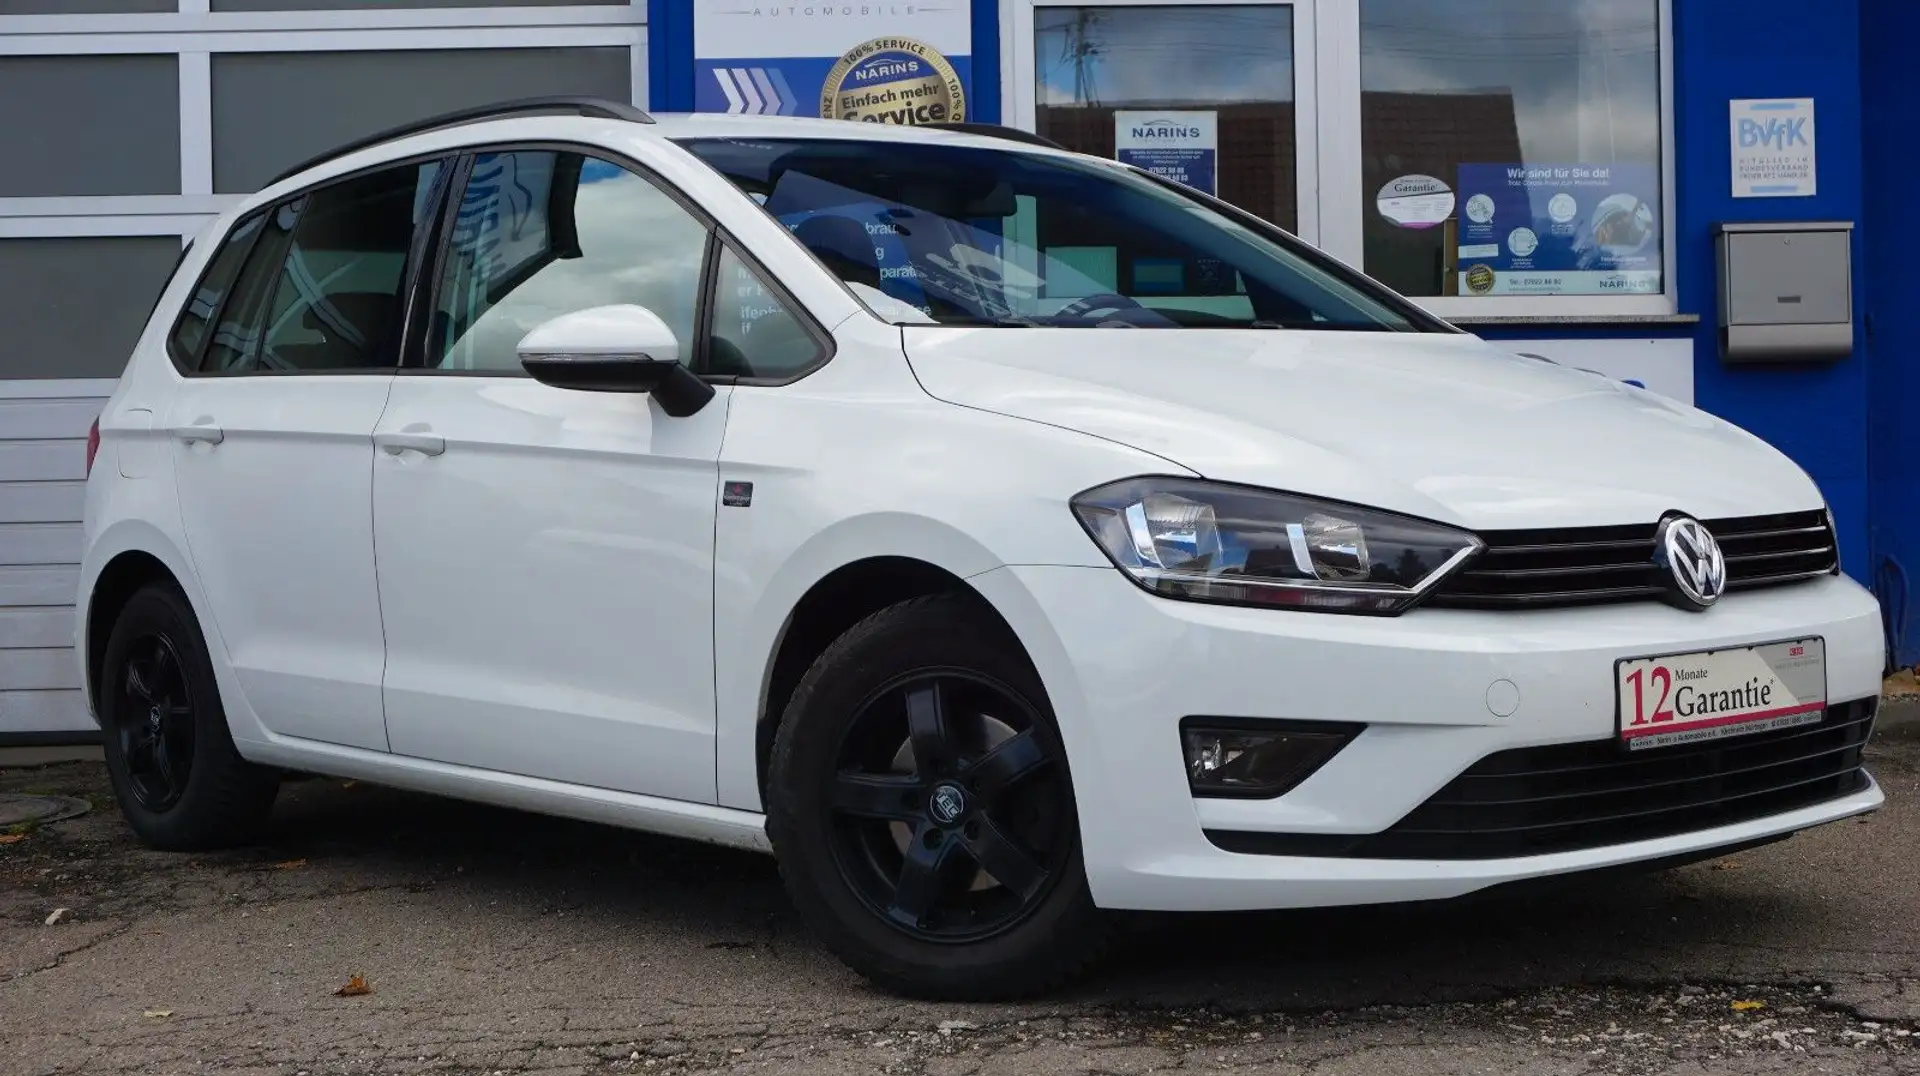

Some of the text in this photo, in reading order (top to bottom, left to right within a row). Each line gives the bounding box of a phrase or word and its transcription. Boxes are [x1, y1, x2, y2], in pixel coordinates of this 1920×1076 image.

[753, 7, 914, 16] AUTOMOBILE
[844, 39, 926, 65] 100% SERVICE
[855, 62, 919, 80] NARINS
[841, 83, 939, 109] Einfach mehr
[948, 79, 962, 110] 100%
[1132, 127, 1200, 138] NARINS
[1507, 168, 1609, 178] Wir sind für Sie da!
[1675, 668, 1708, 682] Monate
[1626, 666, 1673, 725] 12
